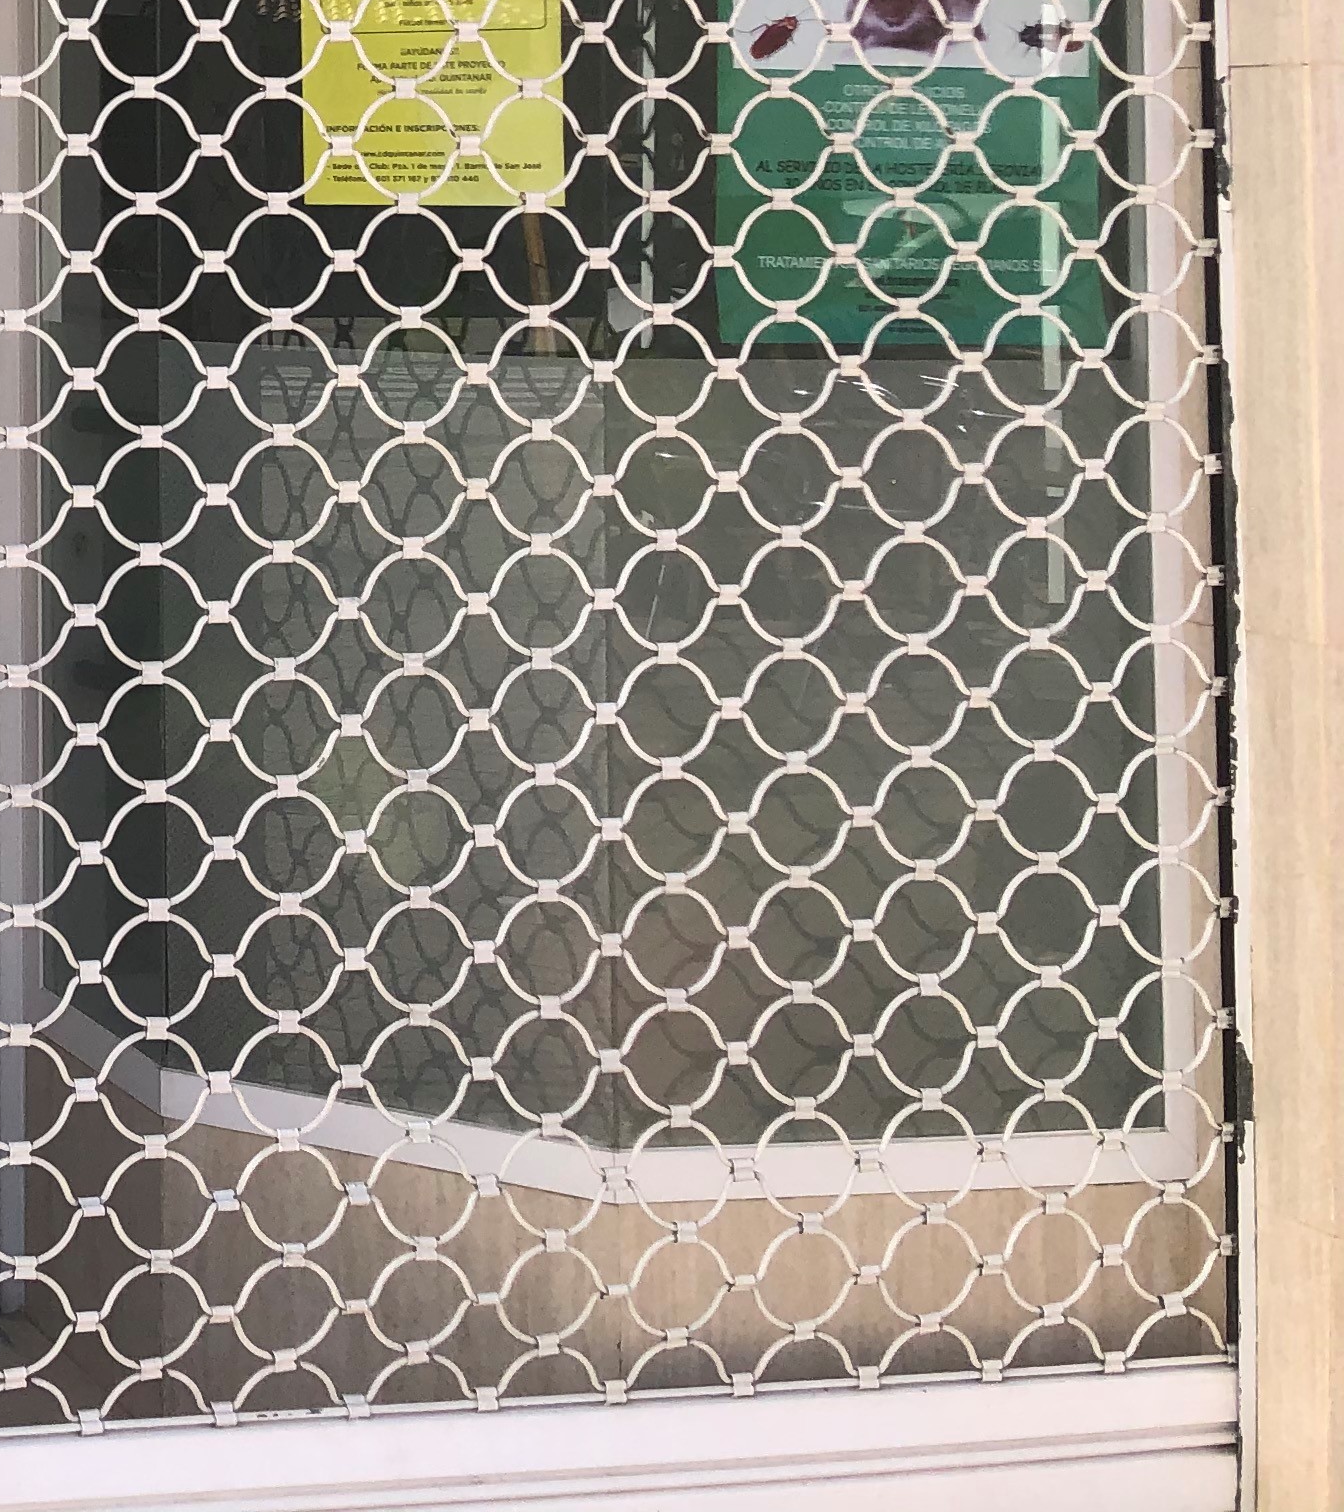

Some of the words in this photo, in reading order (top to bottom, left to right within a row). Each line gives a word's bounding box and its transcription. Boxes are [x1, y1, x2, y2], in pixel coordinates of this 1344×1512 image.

[457, 60, 506, 69] PROYEO
[326, 124, 392, 133] INFORACIÓN
[404, 124, 481, 133] INSCRIPCNES:
[757, 256, 860, 270] TRATAMIE
